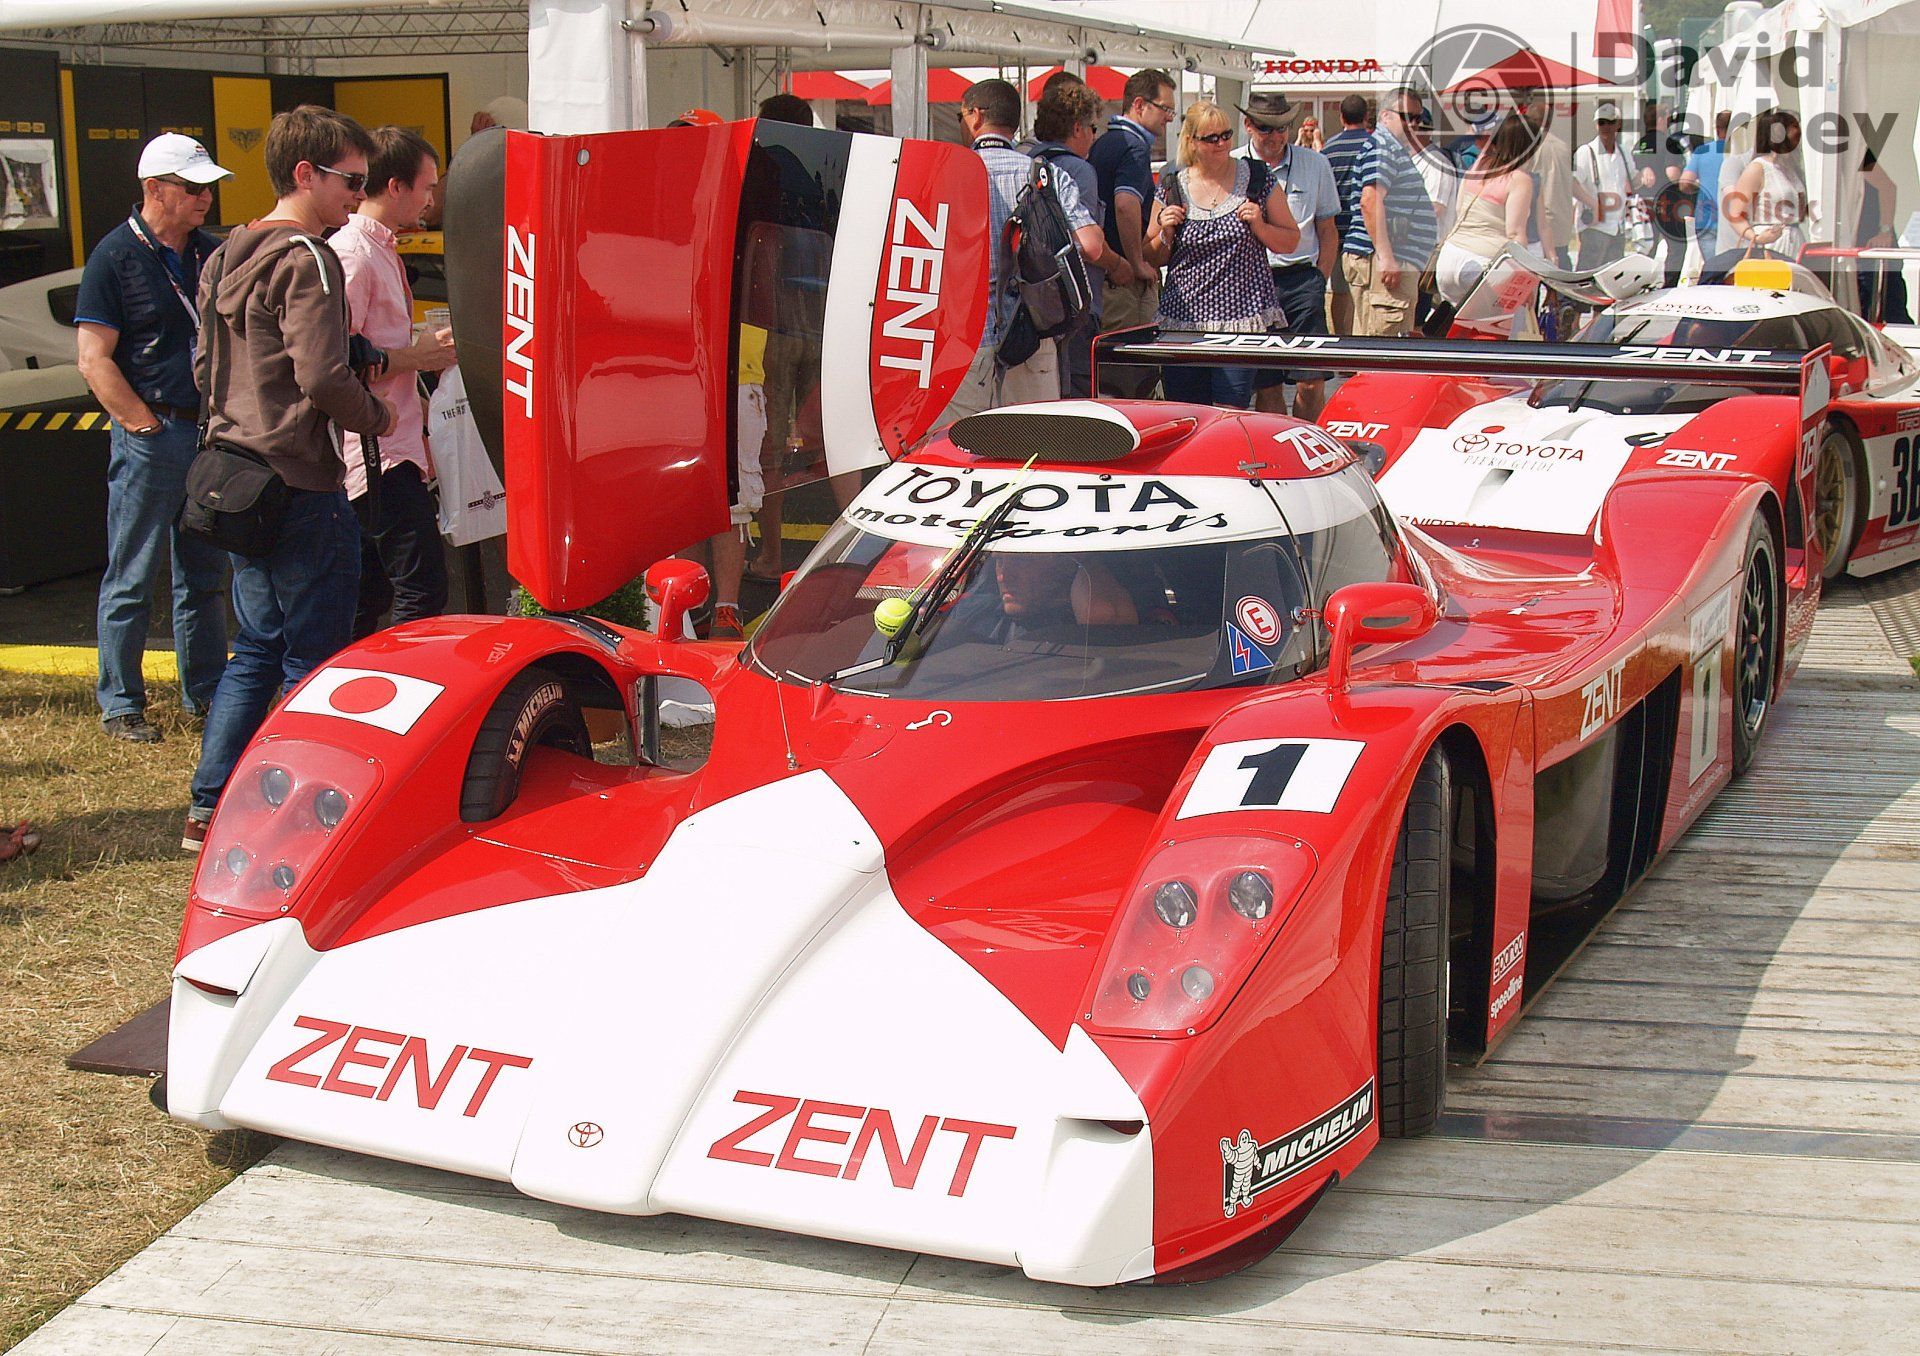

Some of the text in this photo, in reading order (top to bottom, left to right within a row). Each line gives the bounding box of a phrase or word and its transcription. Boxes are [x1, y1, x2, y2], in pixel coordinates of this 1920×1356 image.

[1263, 58, 1384, 74] HONDA
[879, 197, 949, 389] ZENT
[506, 224, 536, 419] ZENT
[1191, 333, 1340, 349] ZENT
[1610, 346, 1772, 363] ZENT
[1325, 421, 1390, 439] ZENT
[1494, 442, 1583, 461] TOYOTA
[1655, 448, 1738, 470] ZENT
[883, 466, 1199, 513] TOYOTA
[1246, 606, 1273, 635] E
[517, 684, 563, 739] MICHELIN
[1579, 657, 1626, 743] ZENT
[1701, 667, 1711, 757] 1
[1237, 743, 1310, 806] 1
[1490, 974, 1523, 1019] speedline
[265, 1015, 533, 1118] ZENT
[706, 1089, 1018, 1198] ZENT
[1261, 1089, 1372, 1178] MICHELIN
